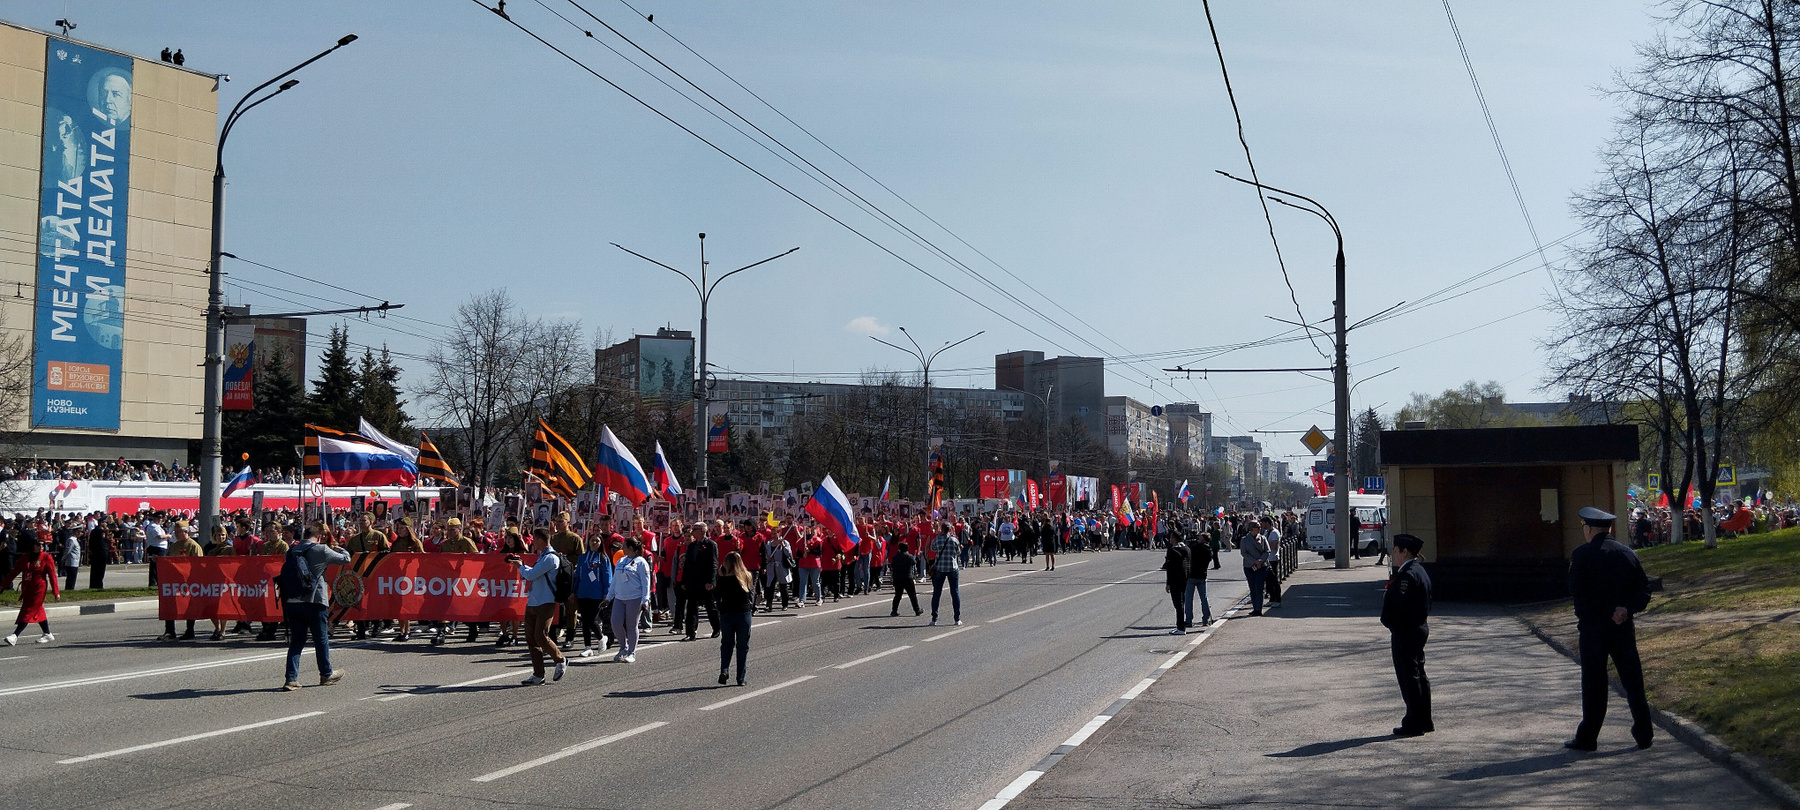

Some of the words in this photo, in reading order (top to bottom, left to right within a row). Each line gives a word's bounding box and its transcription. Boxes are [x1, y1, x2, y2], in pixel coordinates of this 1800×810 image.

[51, 175, 83, 342] МЕЧТАТЬ
[85, 275, 111, 301] И
[46, 406, 88, 415] КУЗНЕЦК
[47, 398, 73, 407] НОВО
[161, 579, 269, 598] БЕССМЕРТНЫЙ
[377, 576, 530, 598] НОВОКУЗНЕЦ
